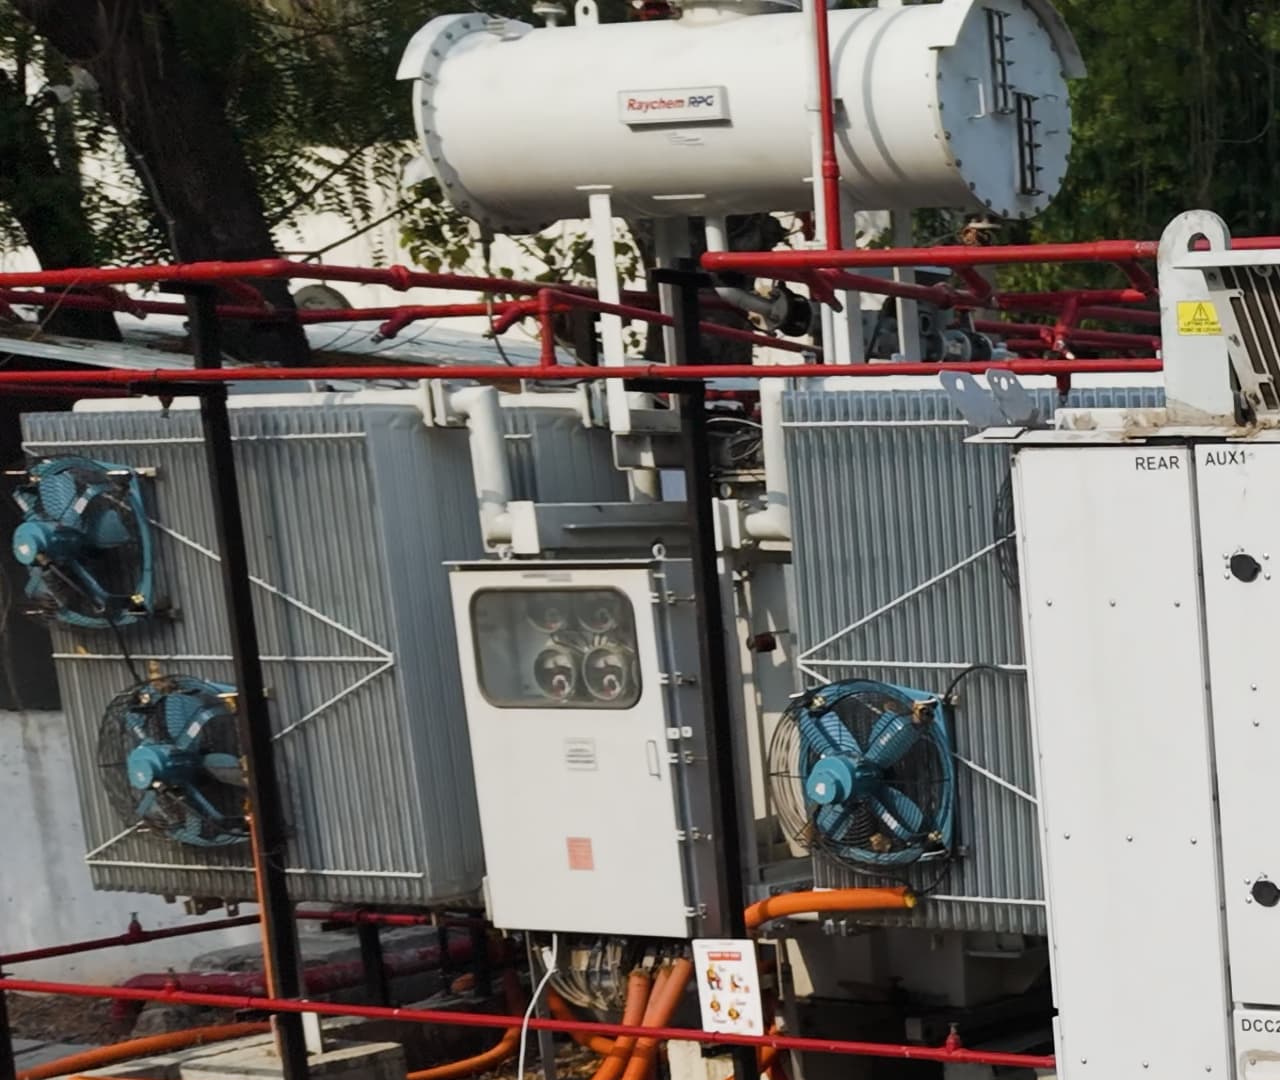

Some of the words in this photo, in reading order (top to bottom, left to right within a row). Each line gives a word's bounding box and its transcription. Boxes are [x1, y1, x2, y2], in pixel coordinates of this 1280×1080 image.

[627, 98, 685, 113] Raychem
[687, 95, 715, 108] RPG
[1135, 455, 1180, 470] REAR
[1205, 450, 1246, 466] AUX1
